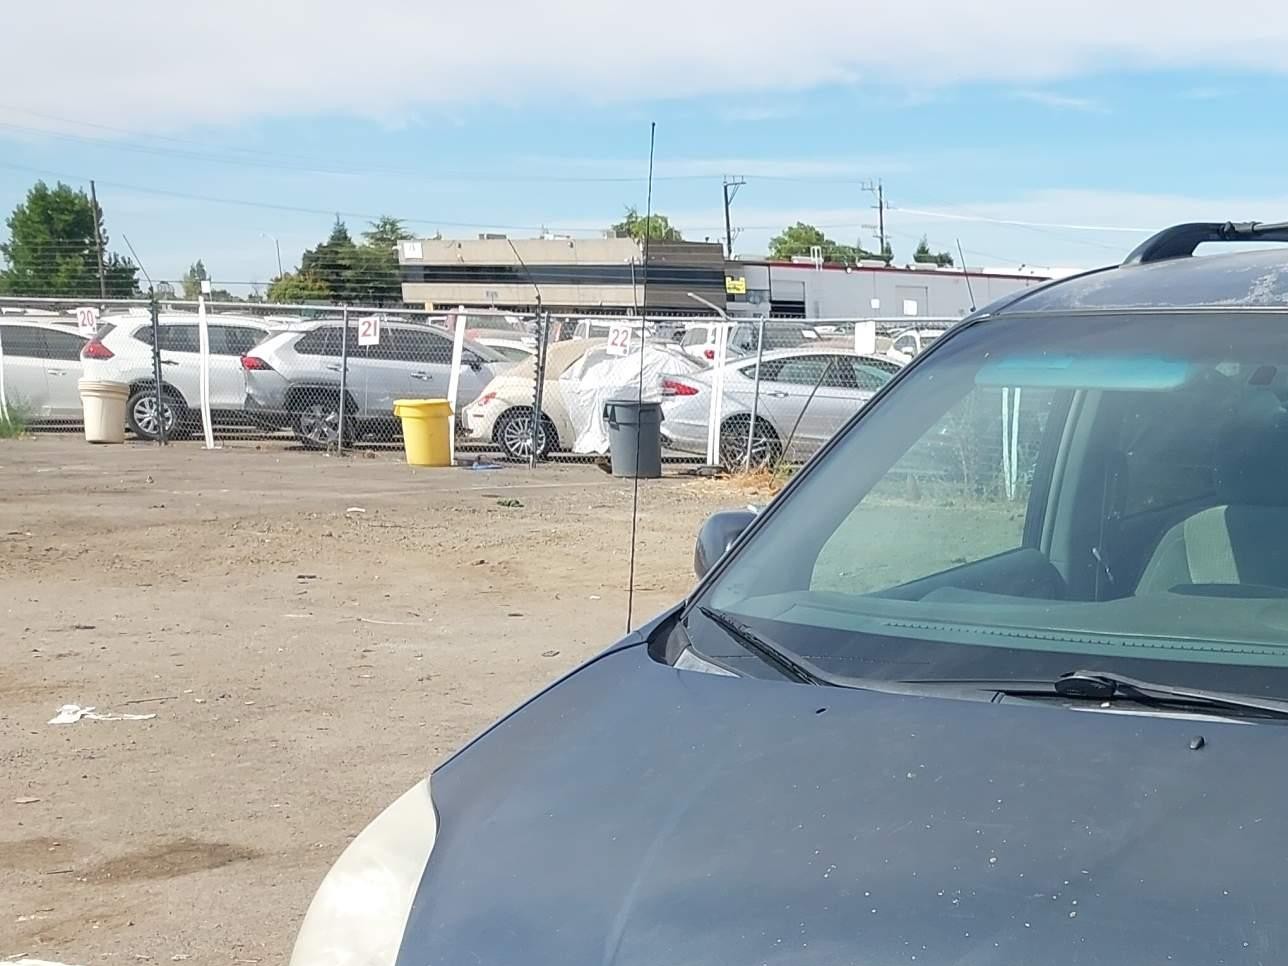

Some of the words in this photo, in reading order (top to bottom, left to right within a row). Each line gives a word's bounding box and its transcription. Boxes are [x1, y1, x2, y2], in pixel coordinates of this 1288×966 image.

[80, 310, 94, 326] 20
[361, 319, 378, 338] 21
[611, 329, 628, 347] 22
